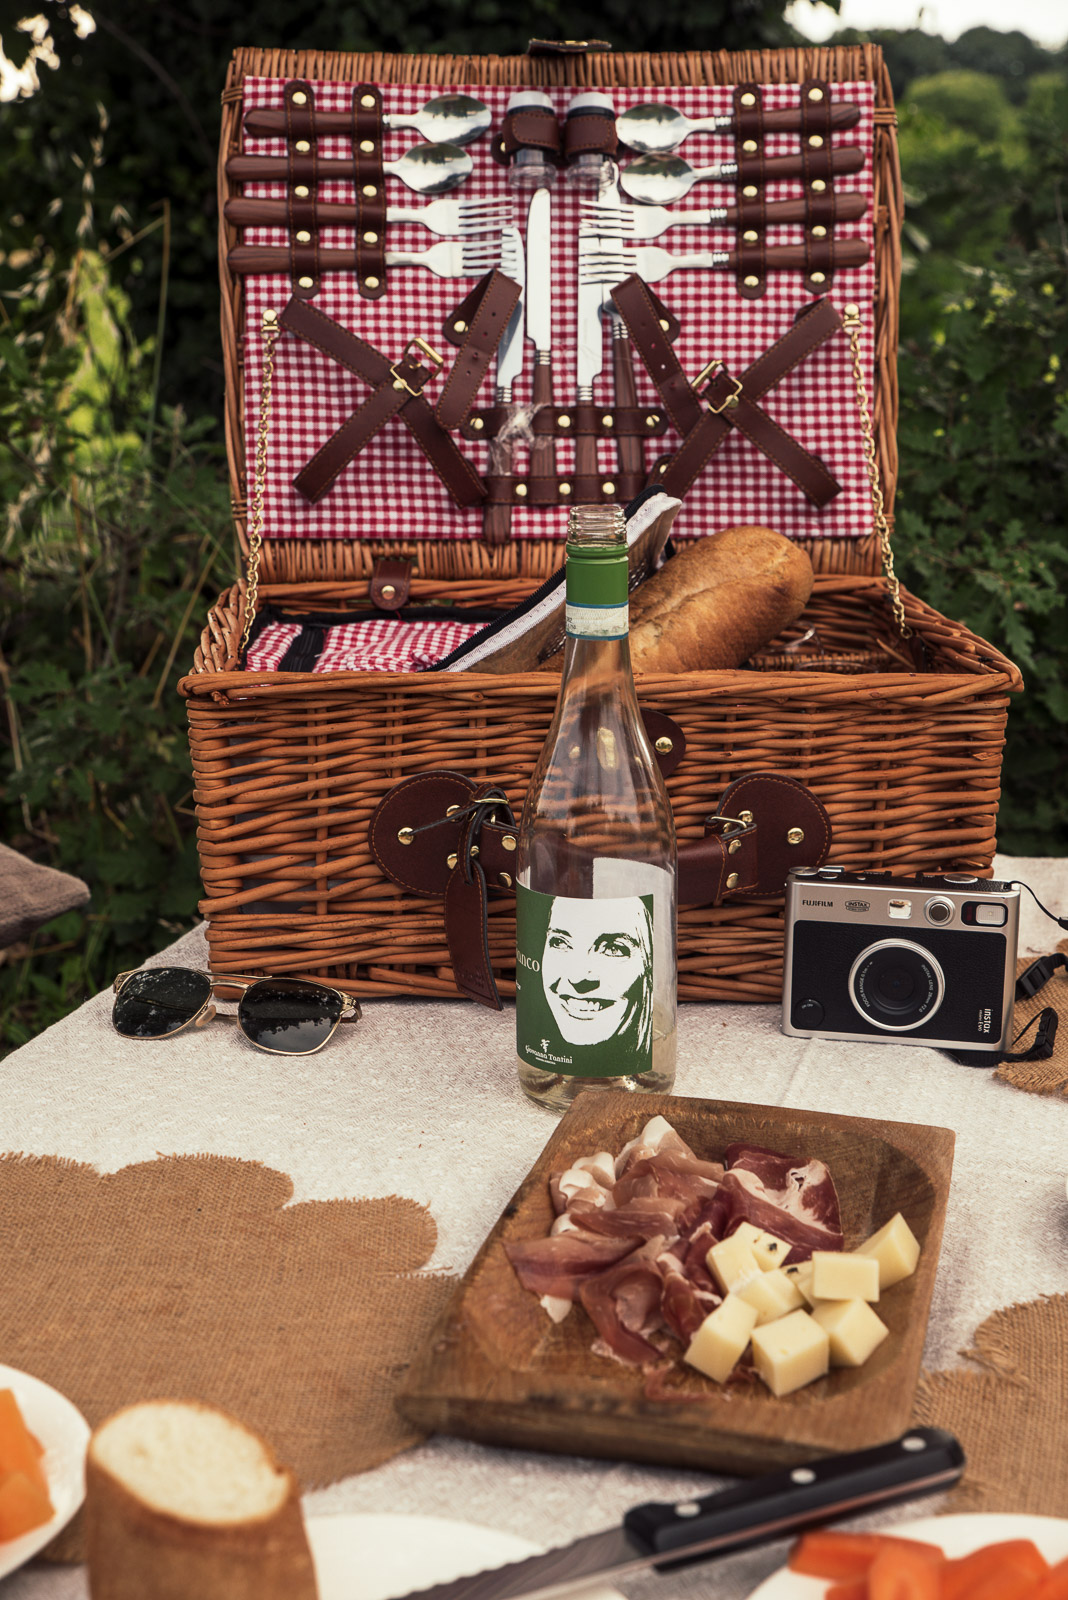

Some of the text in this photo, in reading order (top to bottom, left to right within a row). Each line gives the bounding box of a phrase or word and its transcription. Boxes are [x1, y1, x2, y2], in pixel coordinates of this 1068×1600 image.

[802, 899, 834, 908] FUJIFILM
[983, 1008, 994, 1034] instax
[548, 1053, 573, 1064] Tantini
